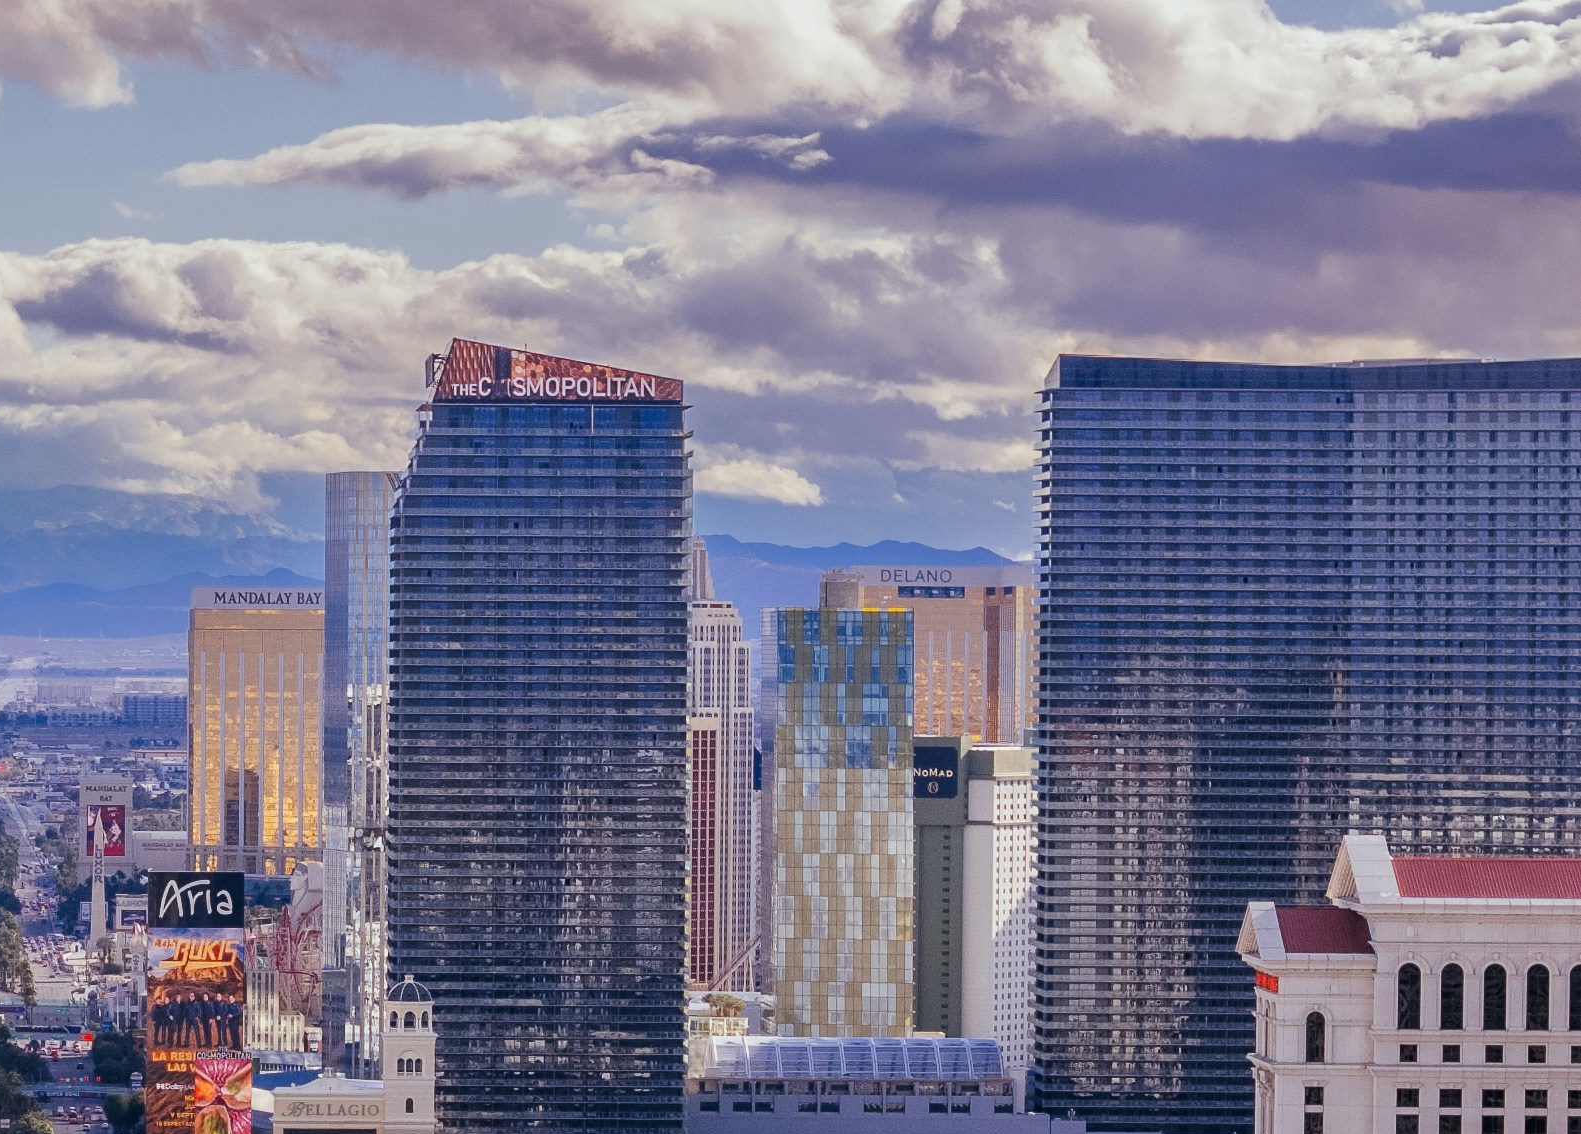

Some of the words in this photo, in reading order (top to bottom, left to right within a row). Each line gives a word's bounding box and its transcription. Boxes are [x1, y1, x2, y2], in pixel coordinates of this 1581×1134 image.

[452, 384, 477, 396] THE
[479, 377, 656, 397] CSMOPOLITAN
[881, 569, 952, 583] DELANO
[214, 592, 292, 604] MANDALAY
[297, 592, 322, 604] BAY
[94, 845, 103, 884] LUXOR
[159, 880, 233, 918] Aria
[173, 938, 239, 967] BUKIS
[152, 1052, 166, 1061] LA
[196, 1051, 252, 1060] COSMOPOLITAN
[167, 1064, 186, 1072] LAS
[282, 1102, 380, 1116] BELLAGIO
